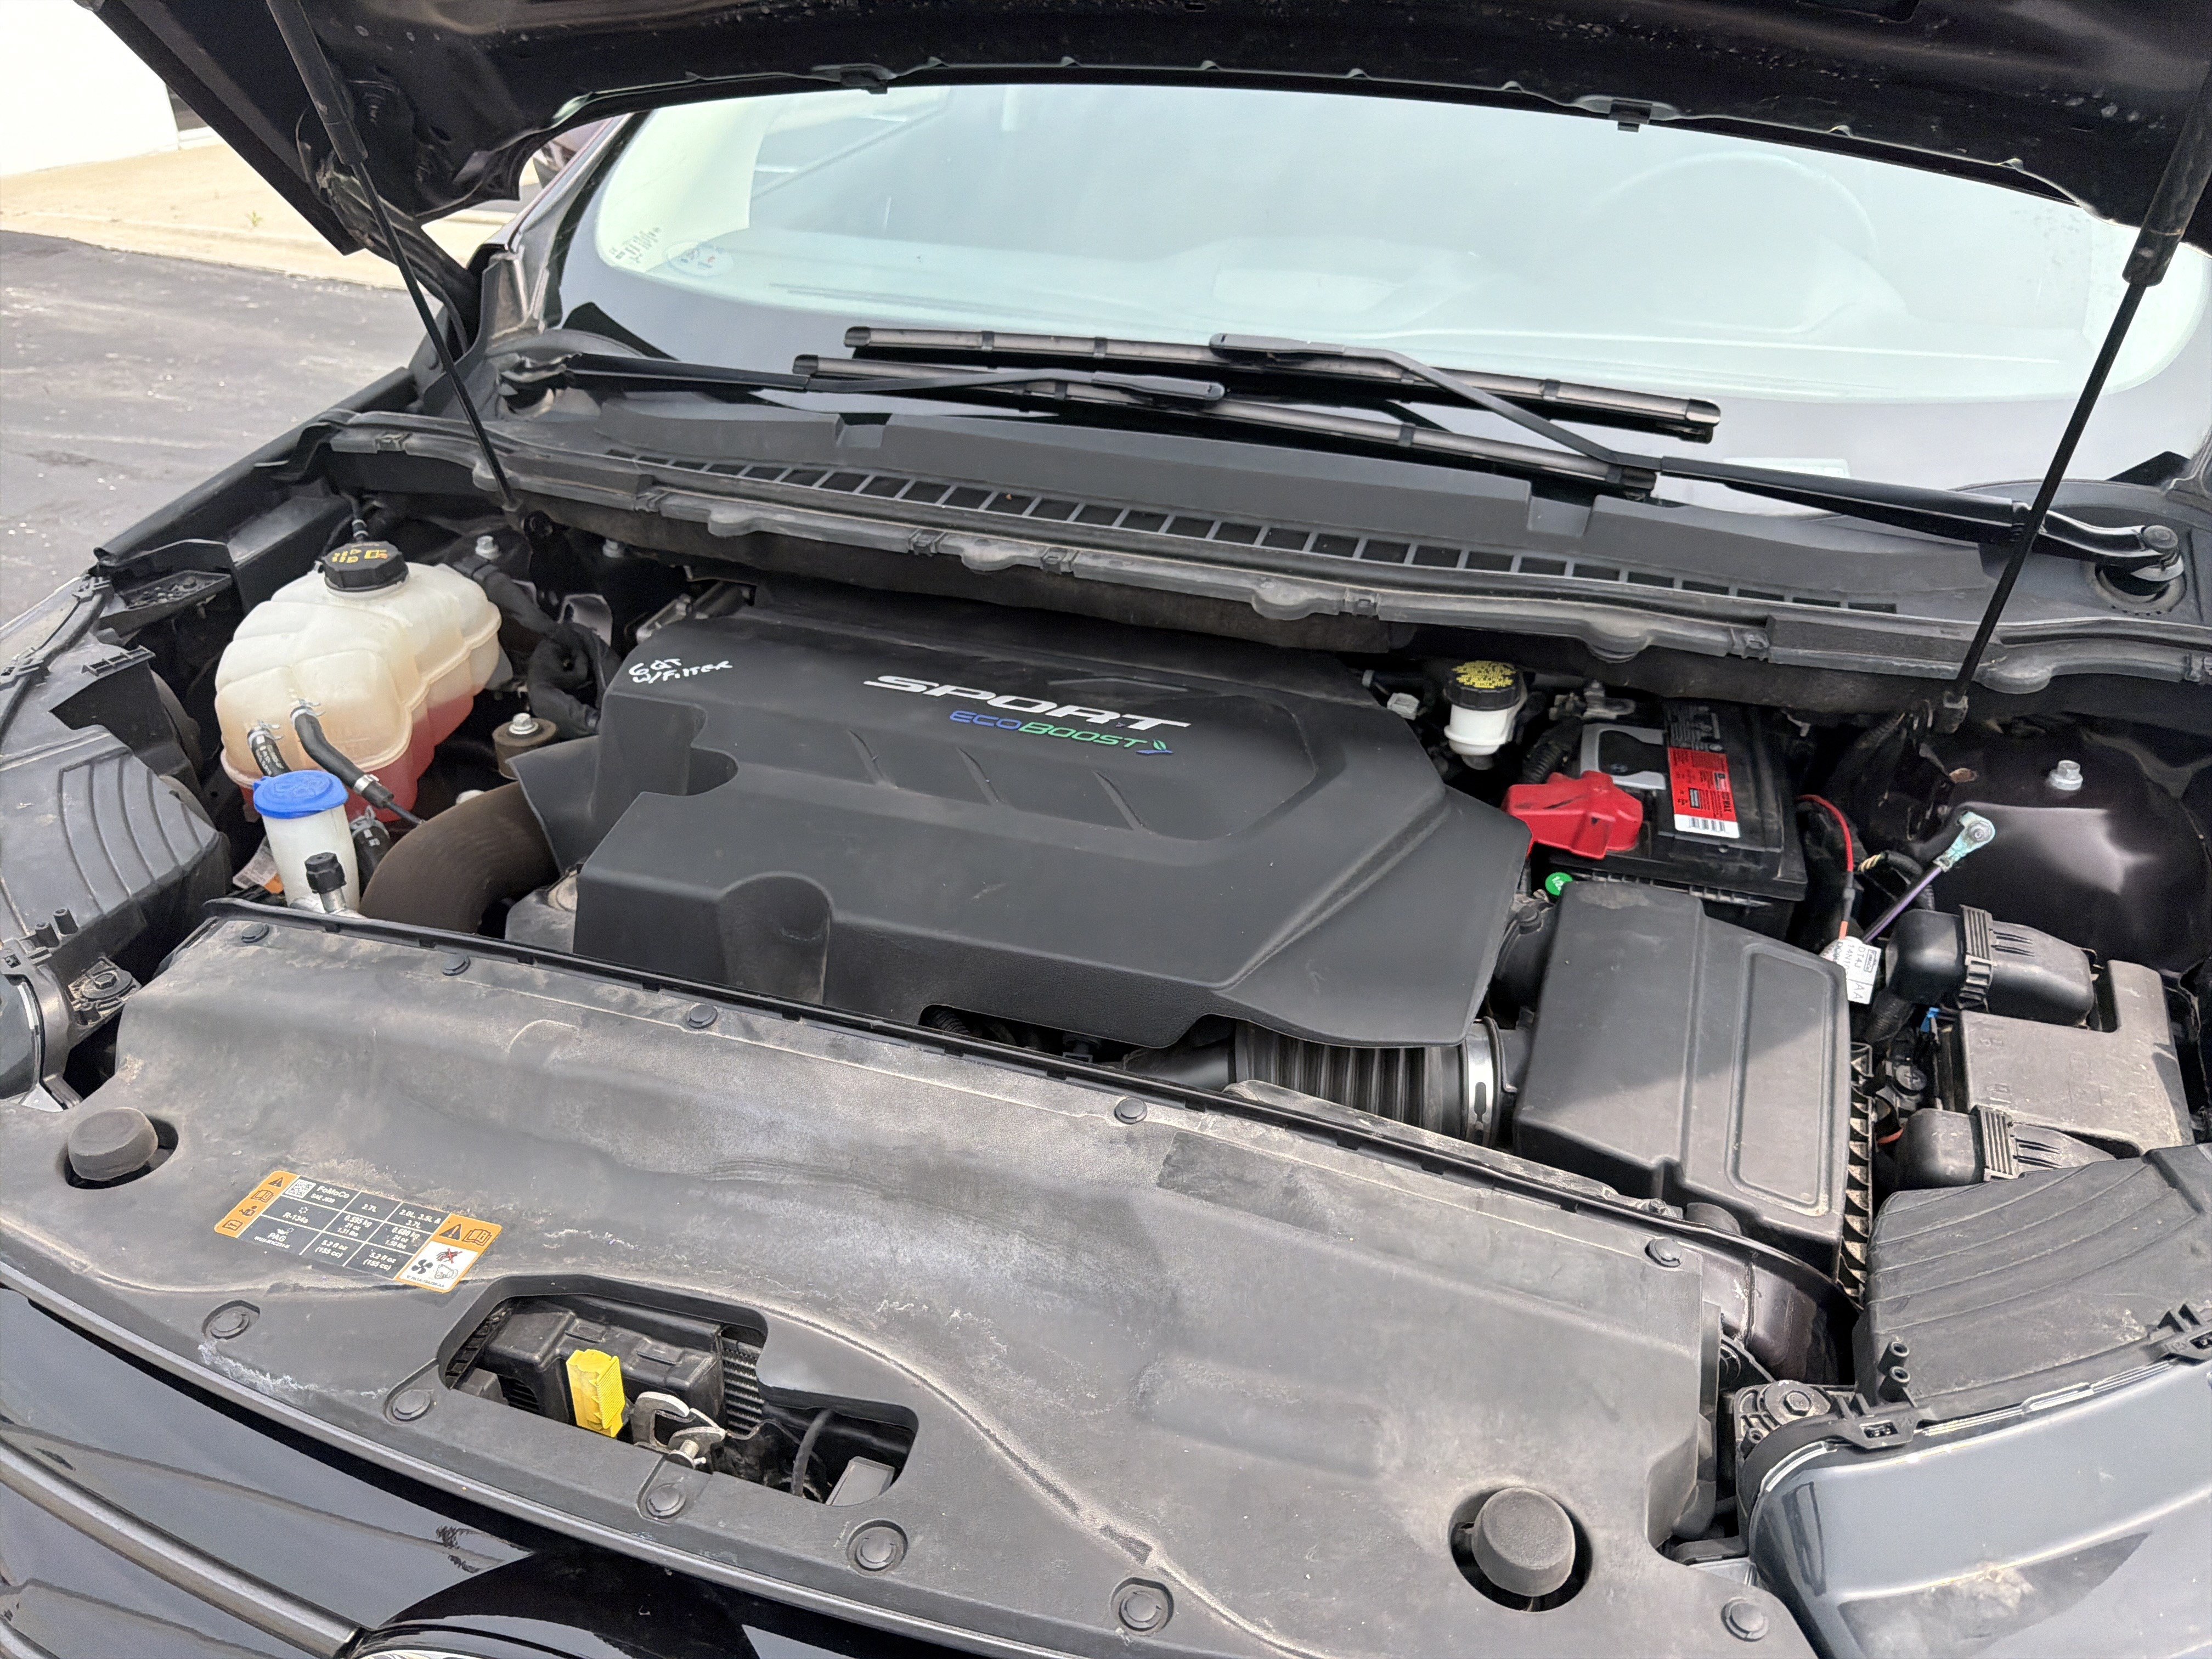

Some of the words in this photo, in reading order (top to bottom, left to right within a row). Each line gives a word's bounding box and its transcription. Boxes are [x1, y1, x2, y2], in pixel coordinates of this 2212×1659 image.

[629, 663, 650, 675] 6
[864, 675, 1191, 730] SPORT
[950, 710, 1148, 749] ECOBOOST
[1843, 945, 1855, 974] 14N10
[1853, 983, 1865, 1000] AA
[317, 1186, 349, 1199] FoMoCo
[362, 1204, 377, 1212] 2.7L
[283, 1212, 308, 1223] R-134a
[344, 1215, 364, 1224] 0.595
[362, 1219, 373, 1228] kg
[399, 1209, 416, 1219] 2.0L,
[418, 1214, 433, 1222] 3.5L
[405, 1220, 421, 1228] 3.7L
[267, 1232, 287, 1242] PAG
[392, 1227, 411, 1236] 0.680
[410, 1232, 421, 1240] kg
[315, 1246, 331, 1255] (155
[363, 1259, 380, 1267] (155
[380, 1263, 392, 1271] cc)
